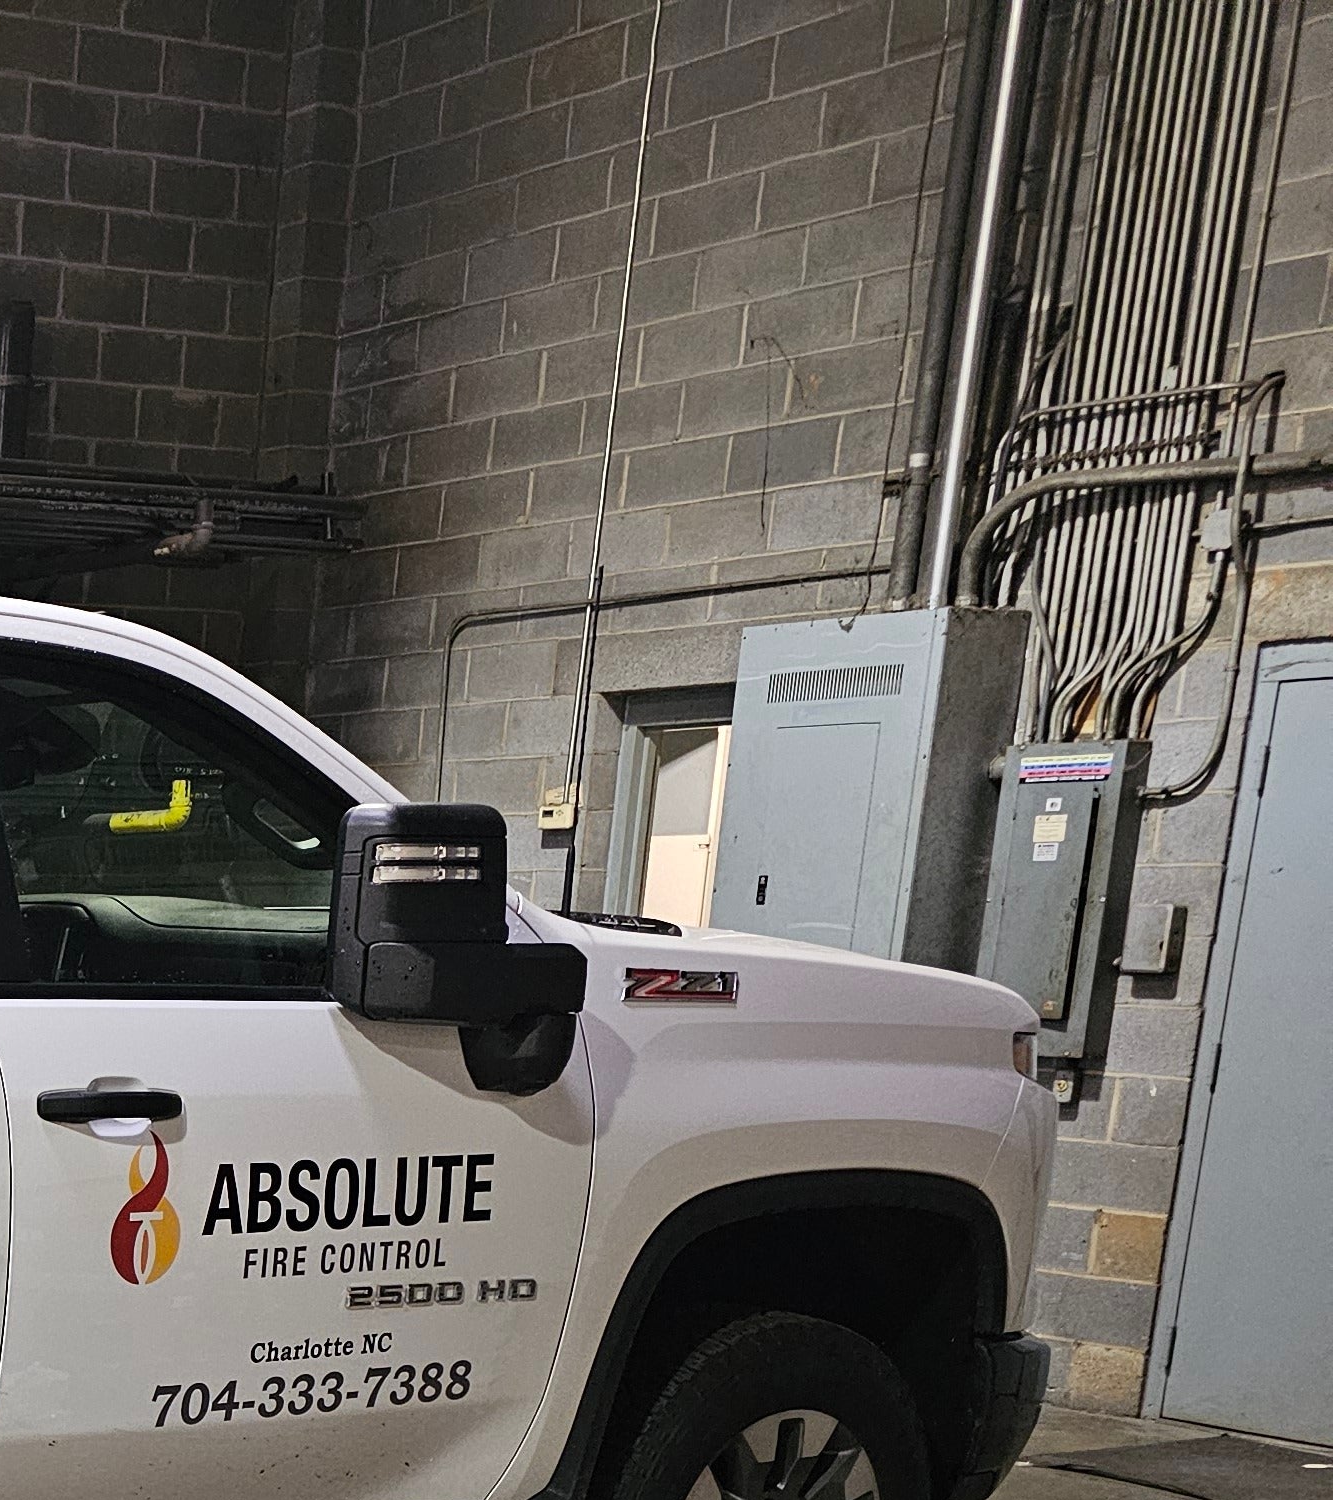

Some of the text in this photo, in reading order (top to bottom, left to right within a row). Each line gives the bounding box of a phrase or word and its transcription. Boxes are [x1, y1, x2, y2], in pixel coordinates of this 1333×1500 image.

[201, 1153, 495, 1236] ABSOLUTE
[242, 1237, 447, 1279] FIRE CONTROL
[345, 1277, 538, 1310] 2500 HD
[250, 1332, 393, 1364] Charlotte NC
[151, 1359, 472, 1428] 704-333-7388
